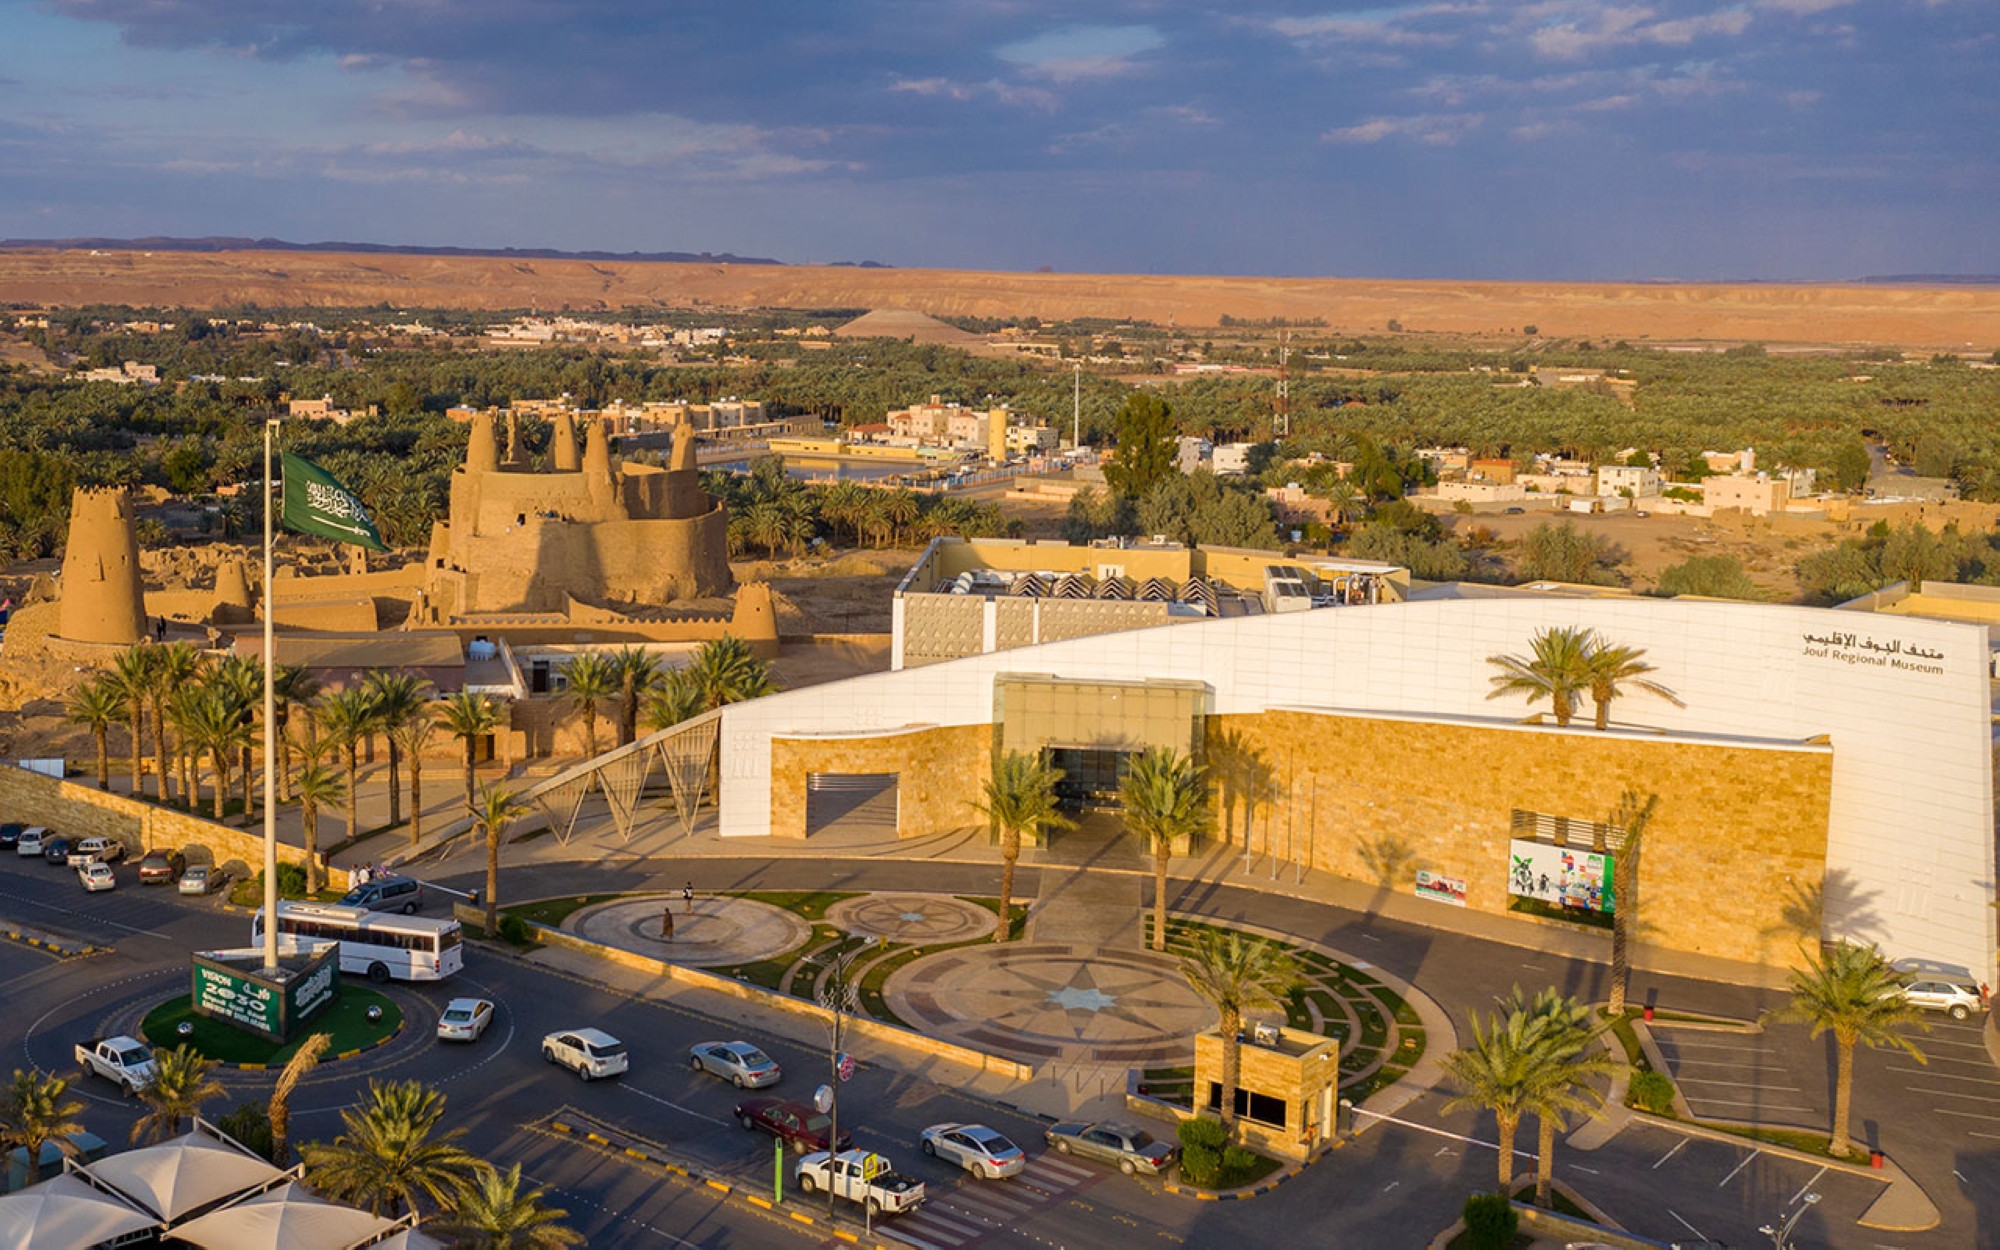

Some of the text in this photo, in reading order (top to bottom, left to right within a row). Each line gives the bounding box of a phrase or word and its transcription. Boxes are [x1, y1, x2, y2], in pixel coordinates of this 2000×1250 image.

[1803, 631, 1944, 660] متحف الجوف الإقليمي
[1802, 647, 1944, 675] Jouf Regional Museum
[202, 968, 231, 986] VISION
